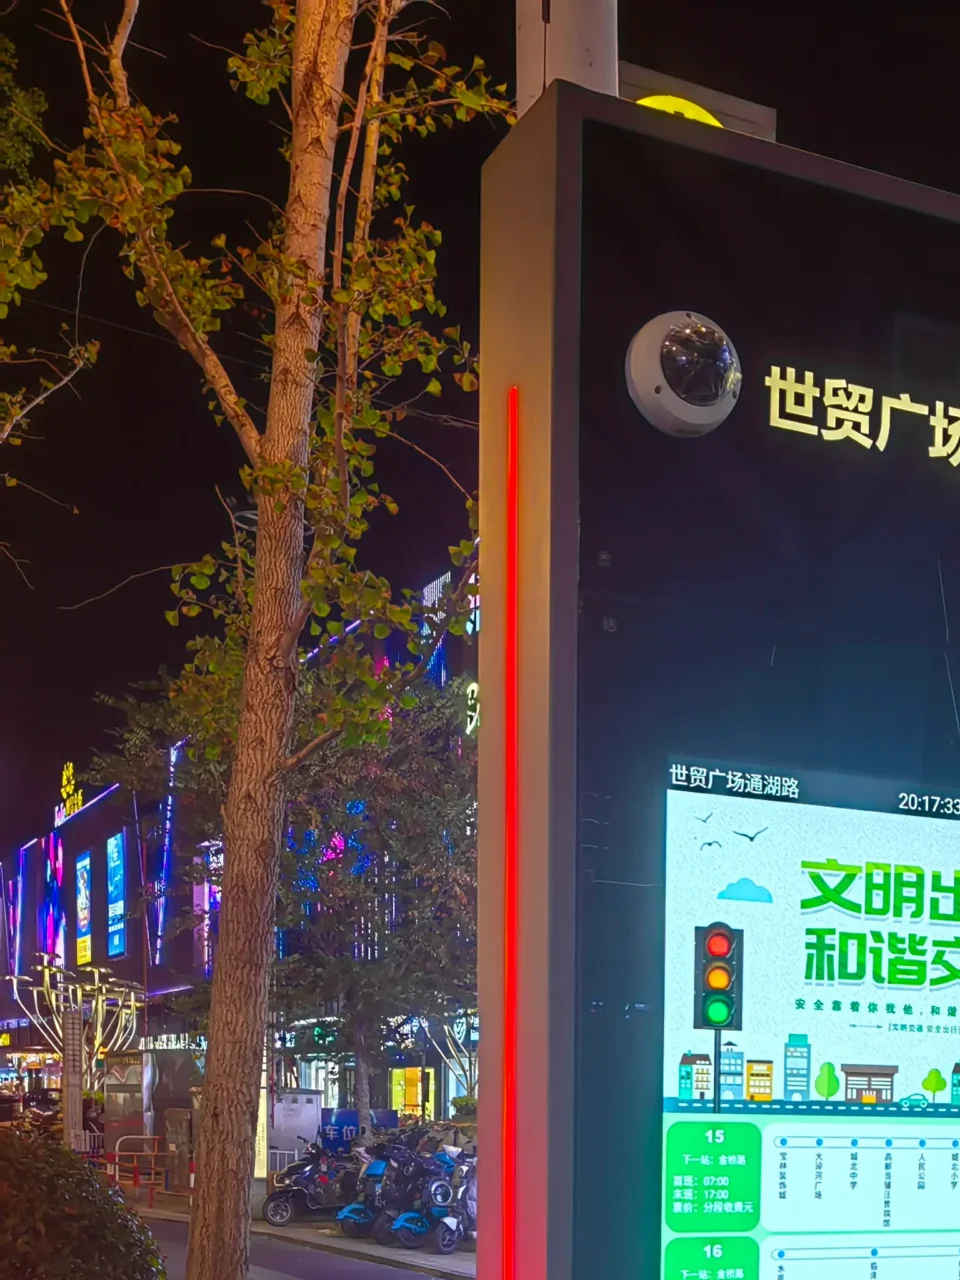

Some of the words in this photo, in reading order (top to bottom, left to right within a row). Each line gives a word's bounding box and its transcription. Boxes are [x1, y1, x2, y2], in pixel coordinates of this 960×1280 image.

[669, 764, 800, 799] 世贸广场通湖路
[704, 1129, 725, 1144] 15
[703, 1244, 723, 1258] 16
